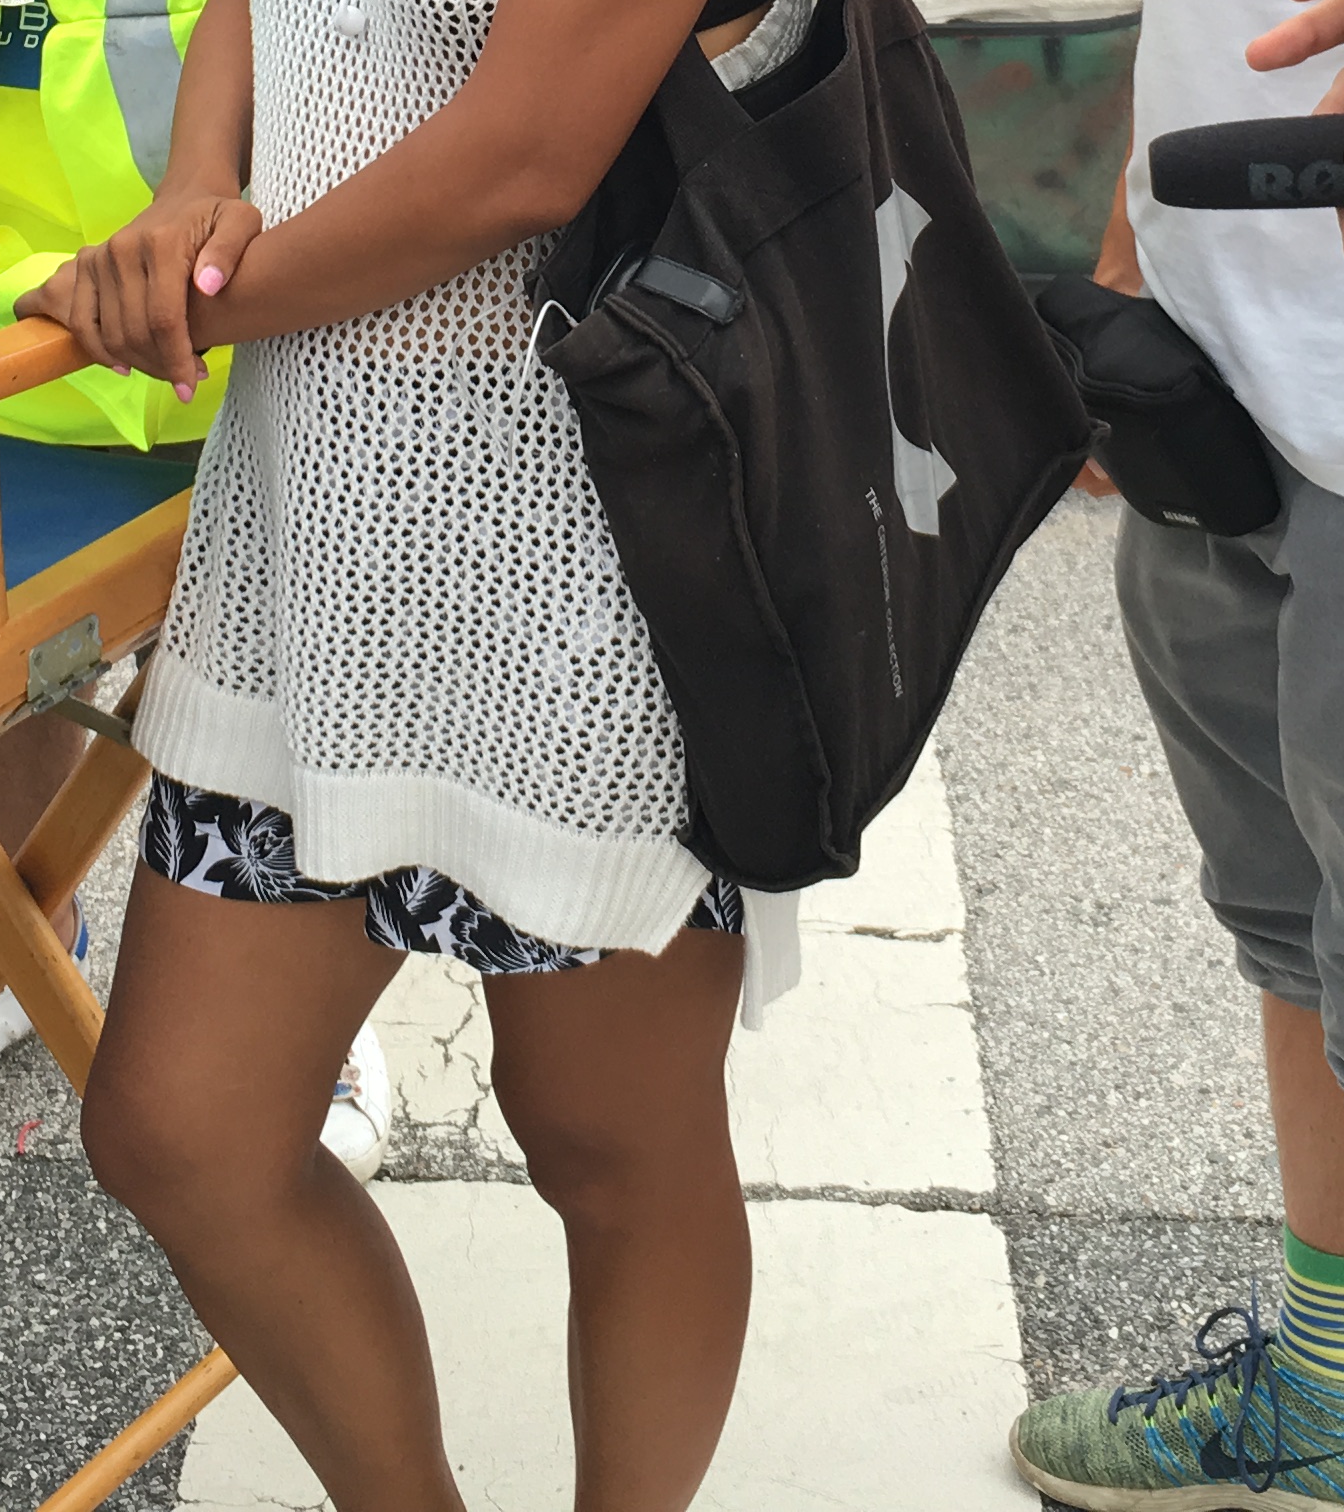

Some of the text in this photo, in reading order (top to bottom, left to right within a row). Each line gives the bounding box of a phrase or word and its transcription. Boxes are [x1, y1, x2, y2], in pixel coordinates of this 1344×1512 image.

[864, 487, 904, 699] THE CRITERION COLLECTION
